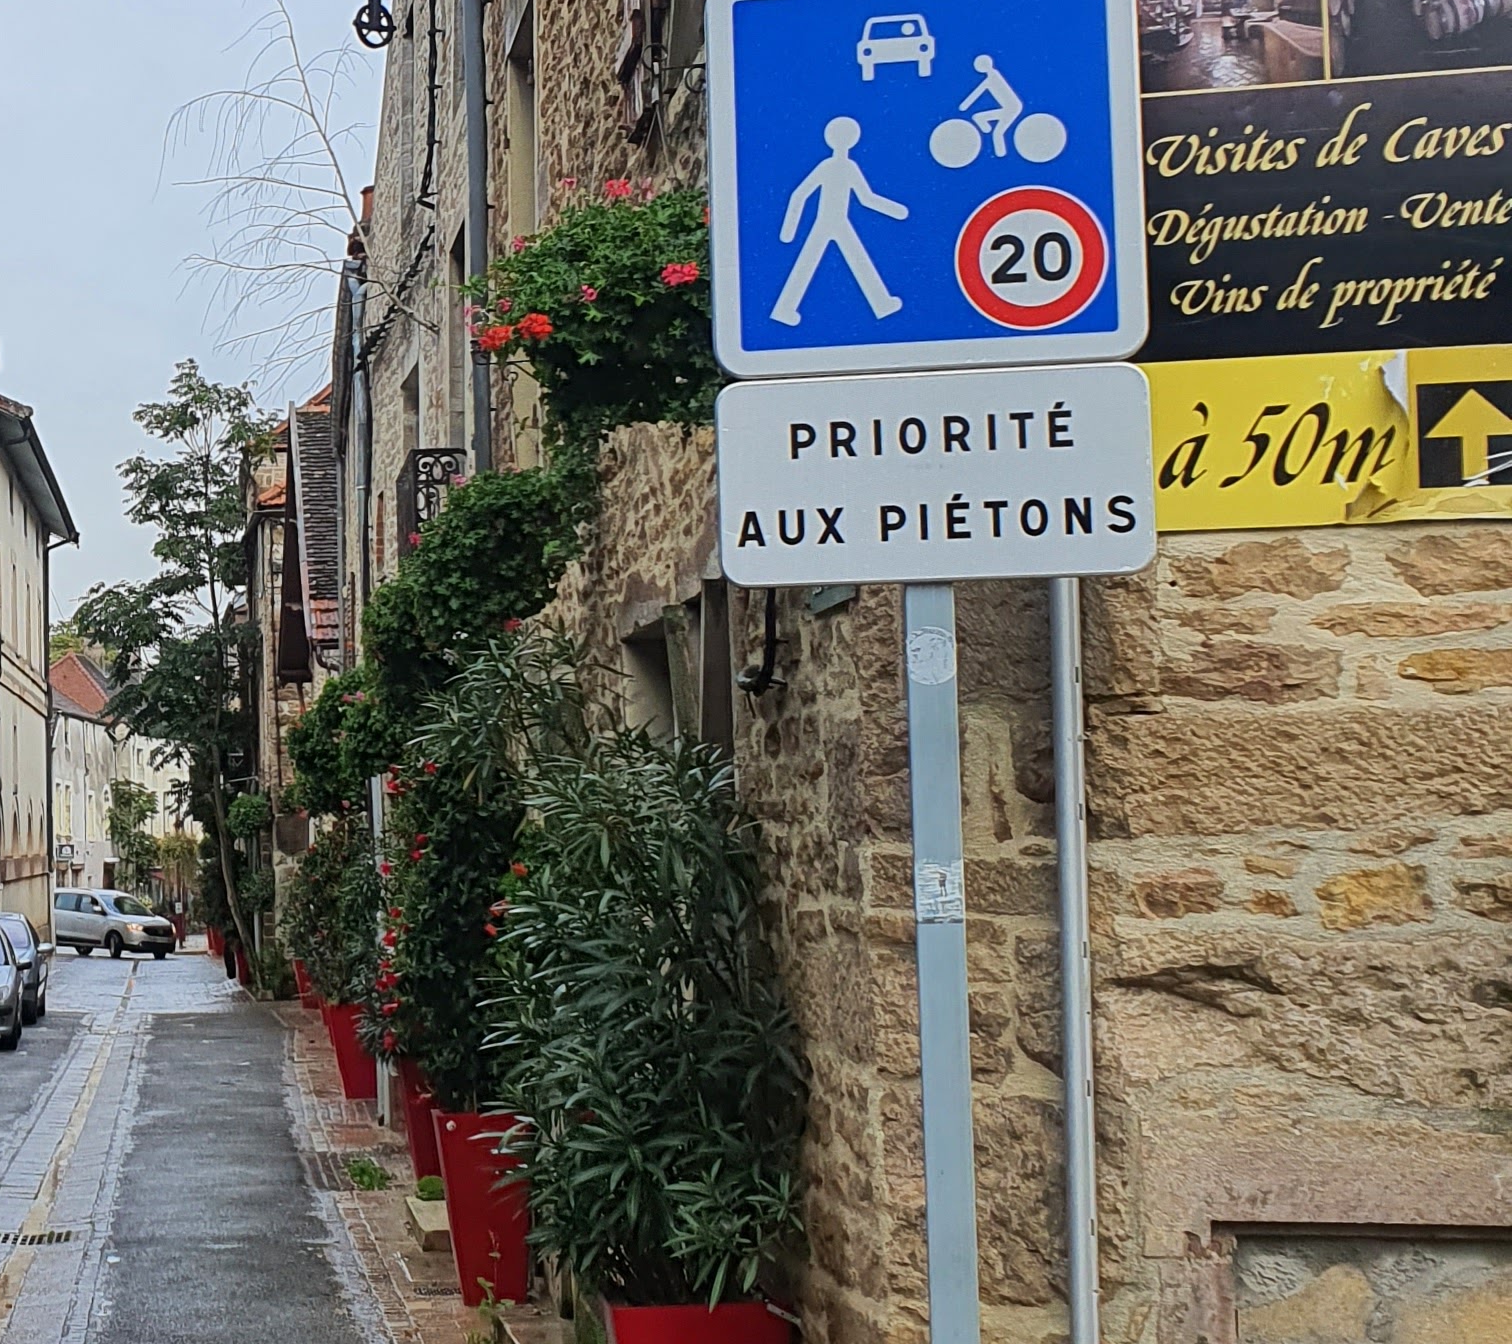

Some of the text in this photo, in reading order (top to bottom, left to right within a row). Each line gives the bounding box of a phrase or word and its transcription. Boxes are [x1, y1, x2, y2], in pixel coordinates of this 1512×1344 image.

[1146, 103, 1511, 177] Visites de Caves
[990, 232, 1072, 284] 20
[1147, 196, 1369, 265] Dégustation
[1170, 256, 1504, 329] Vins de propriété
[790, 401, 1074, 459] PRIORITÉ
[1158, 402, 1396, 489] à 50m
[737, 493, 1137, 547] AUX PIÉTONS
